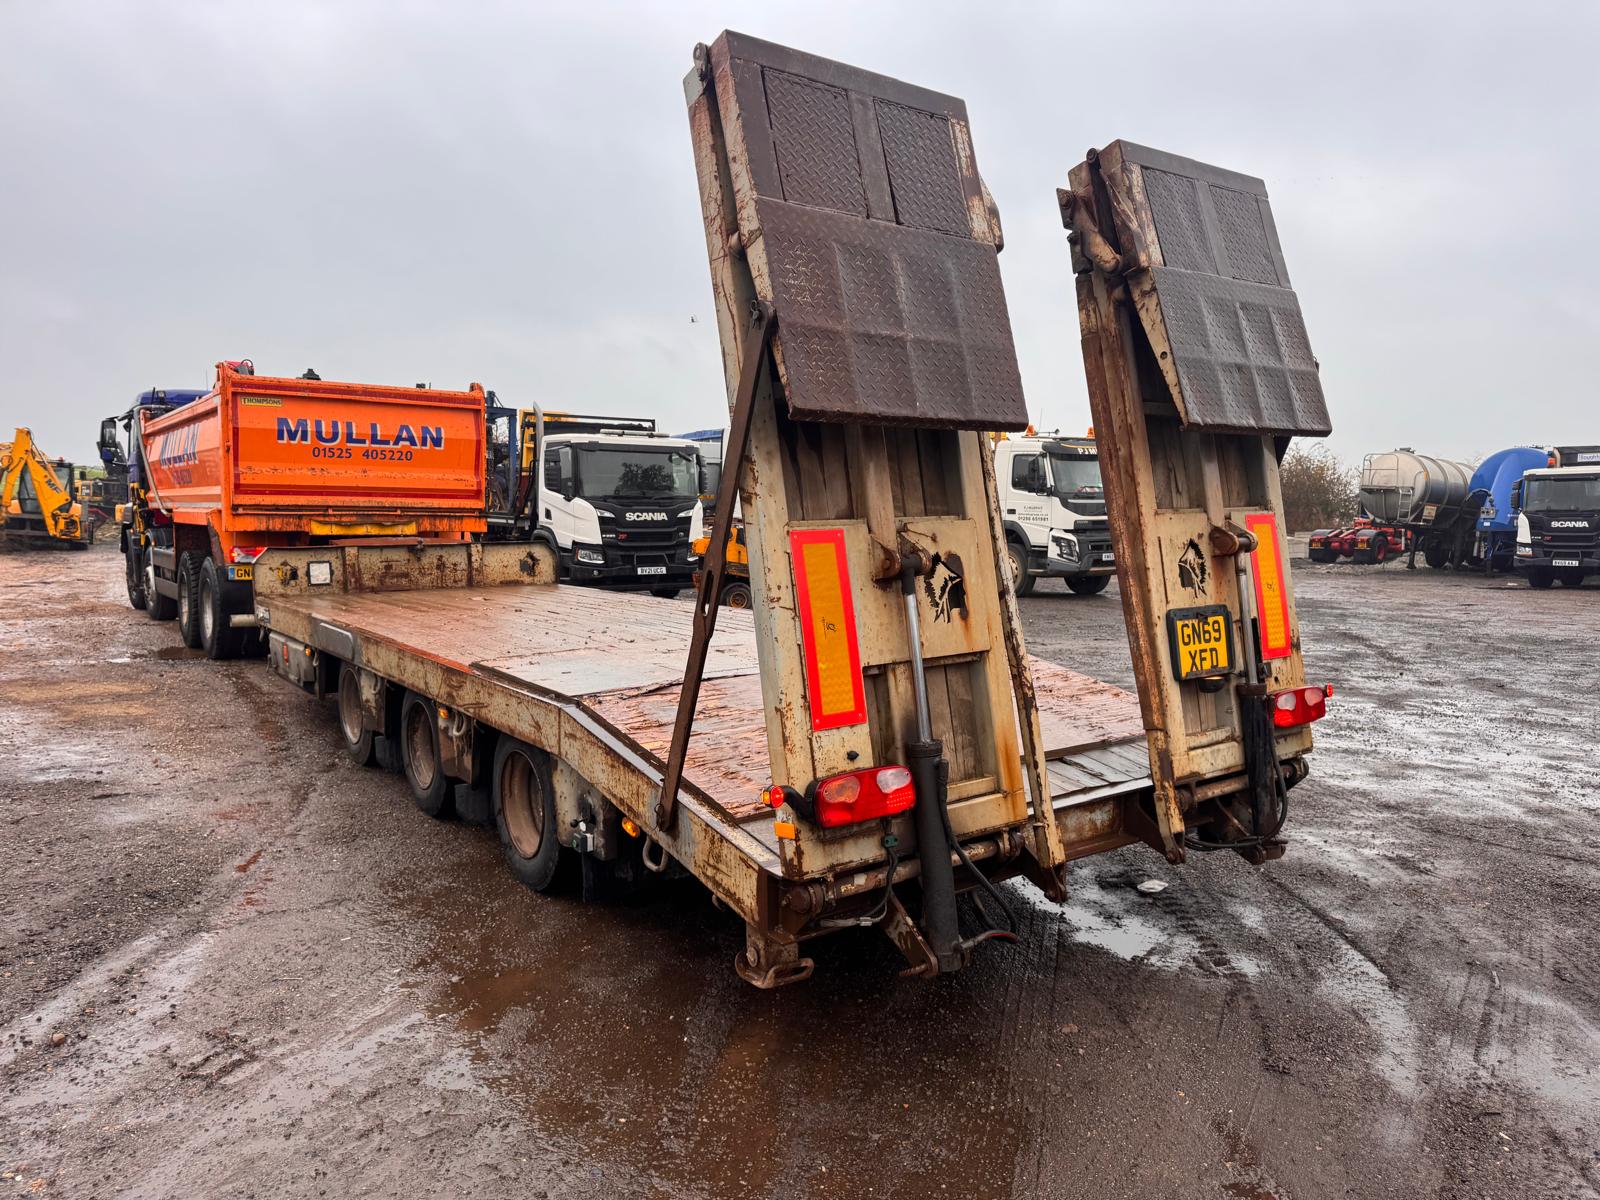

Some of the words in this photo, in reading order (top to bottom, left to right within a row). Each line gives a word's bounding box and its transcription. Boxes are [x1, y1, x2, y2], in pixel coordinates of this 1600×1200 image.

[242, 397, 282, 407] THOMPSONS
[276, 416, 445, 450] MULLAN
[311, 446, 352, 460] 01525
[362, 449, 414, 463] 405220
[46, 479, 61, 494] MF
[625, 512, 668, 521] SCANIA
[1551, 520, 1589, 528] SCANIA
[236, 568, 253, 578] GN
[1181, 620, 1222, 646] GN69
[1189, 648, 1219, 673] XFD
